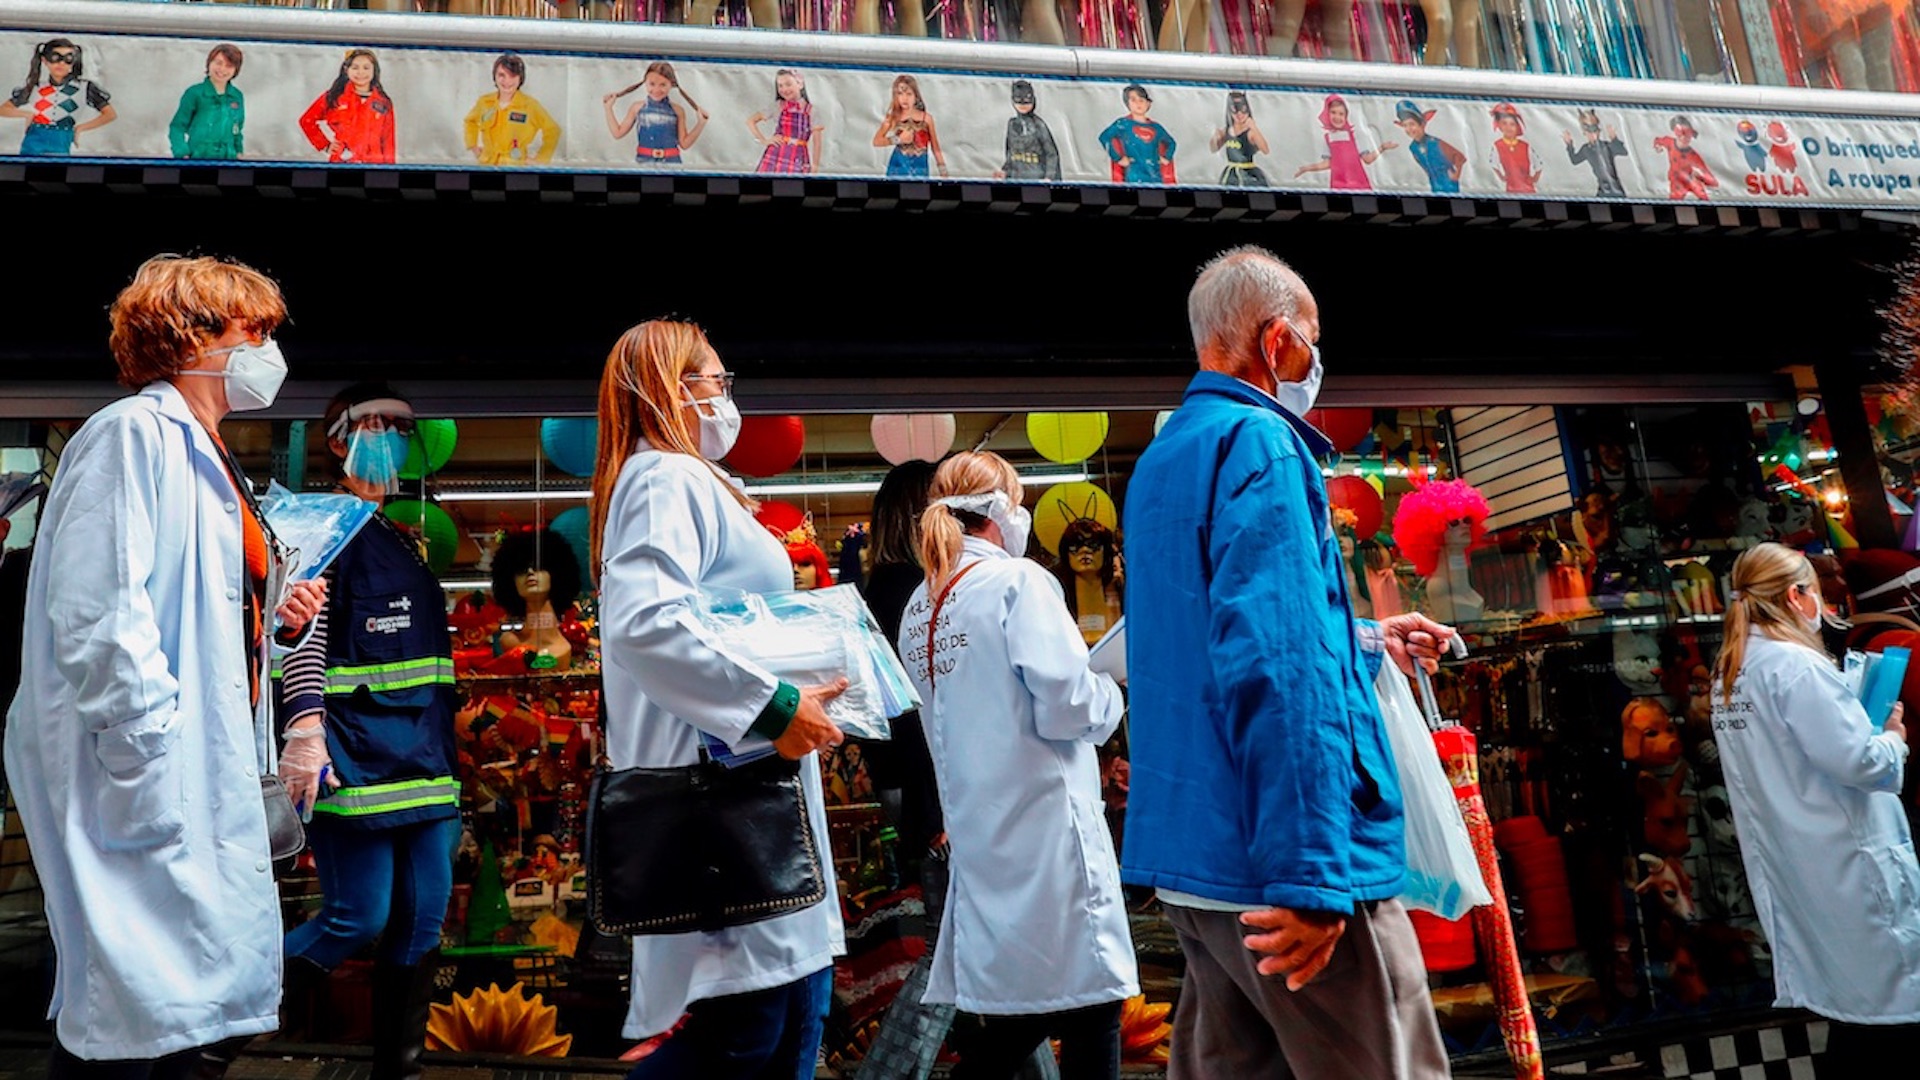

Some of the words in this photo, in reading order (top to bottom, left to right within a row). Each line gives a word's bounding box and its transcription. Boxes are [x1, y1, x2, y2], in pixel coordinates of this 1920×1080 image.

[1802, 137, 1820, 156] O
[1746, 174, 1809, 197] SULA
[1828, 168, 1844, 187] A
[1848, 173, 1911, 195] roupa
[950, 633, 968, 649] DE
[1741, 701, 1754, 713] DE
